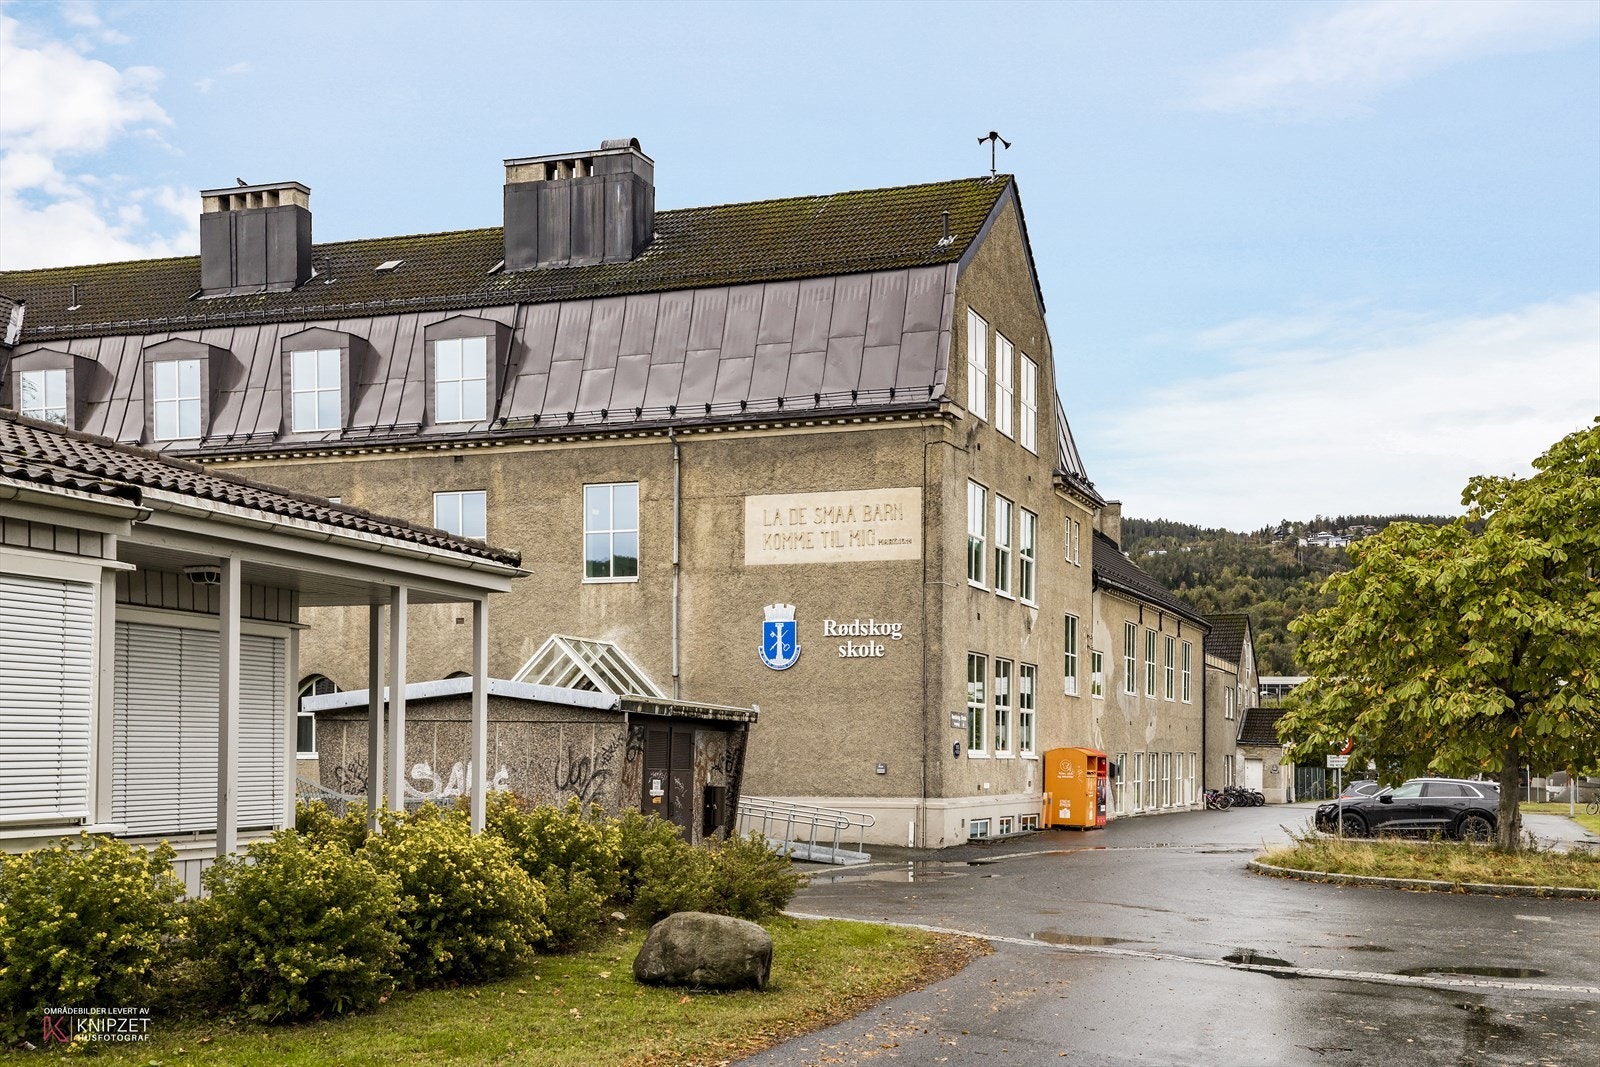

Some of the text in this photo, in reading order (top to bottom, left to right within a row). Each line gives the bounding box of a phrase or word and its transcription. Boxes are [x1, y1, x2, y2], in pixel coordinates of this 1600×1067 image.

[763, 503, 904, 526] LA DE SMAA BARN
[762, 531, 815, 550] KOMME
[821, 530, 844, 549] TIL
[849, 529, 876, 548] MIG
[823, 619, 903, 640] Rødskog
[838, 640, 885, 658] skole
